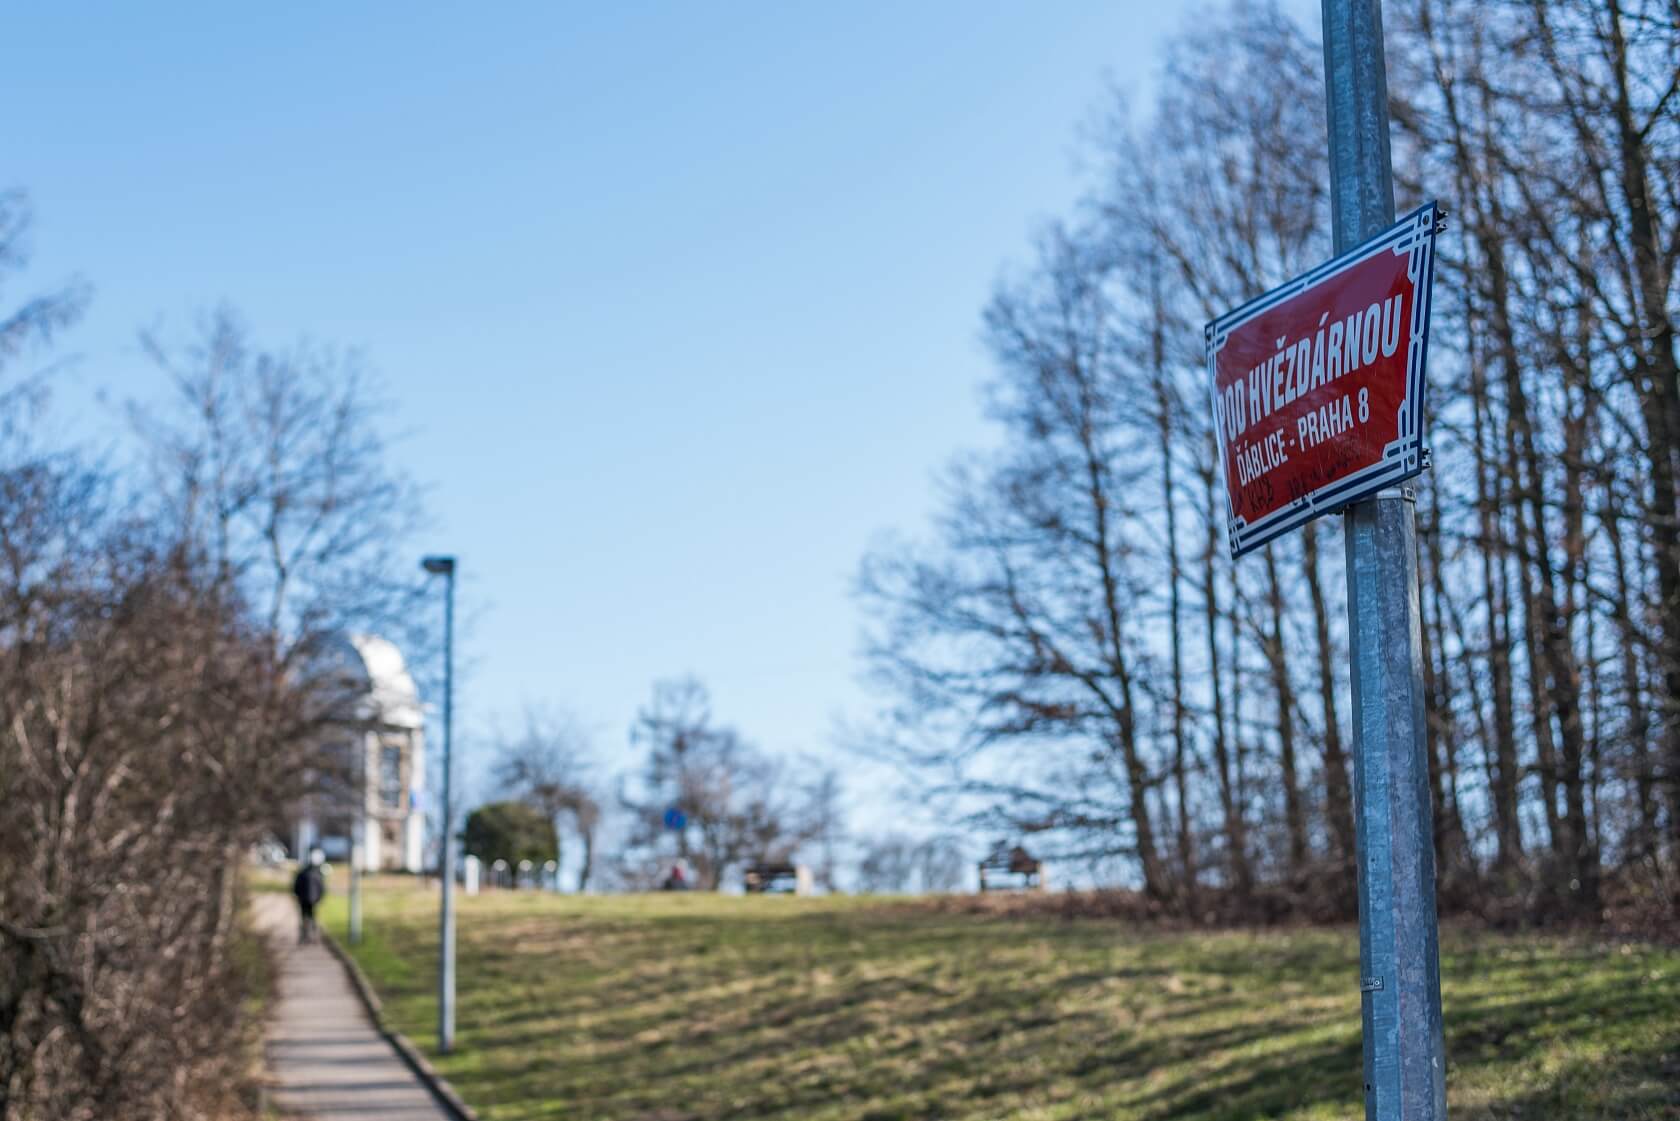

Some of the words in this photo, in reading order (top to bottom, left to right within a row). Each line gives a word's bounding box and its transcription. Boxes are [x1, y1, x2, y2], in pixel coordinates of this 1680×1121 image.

[1249, 293, 1403, 426] HVĚZDÁRNOU
[1236, 427, 1288, 487] ĎÁBLICE
[1297, 394, 1354, 453] PRAHA
[1358, 386, 1370, 424] 8
